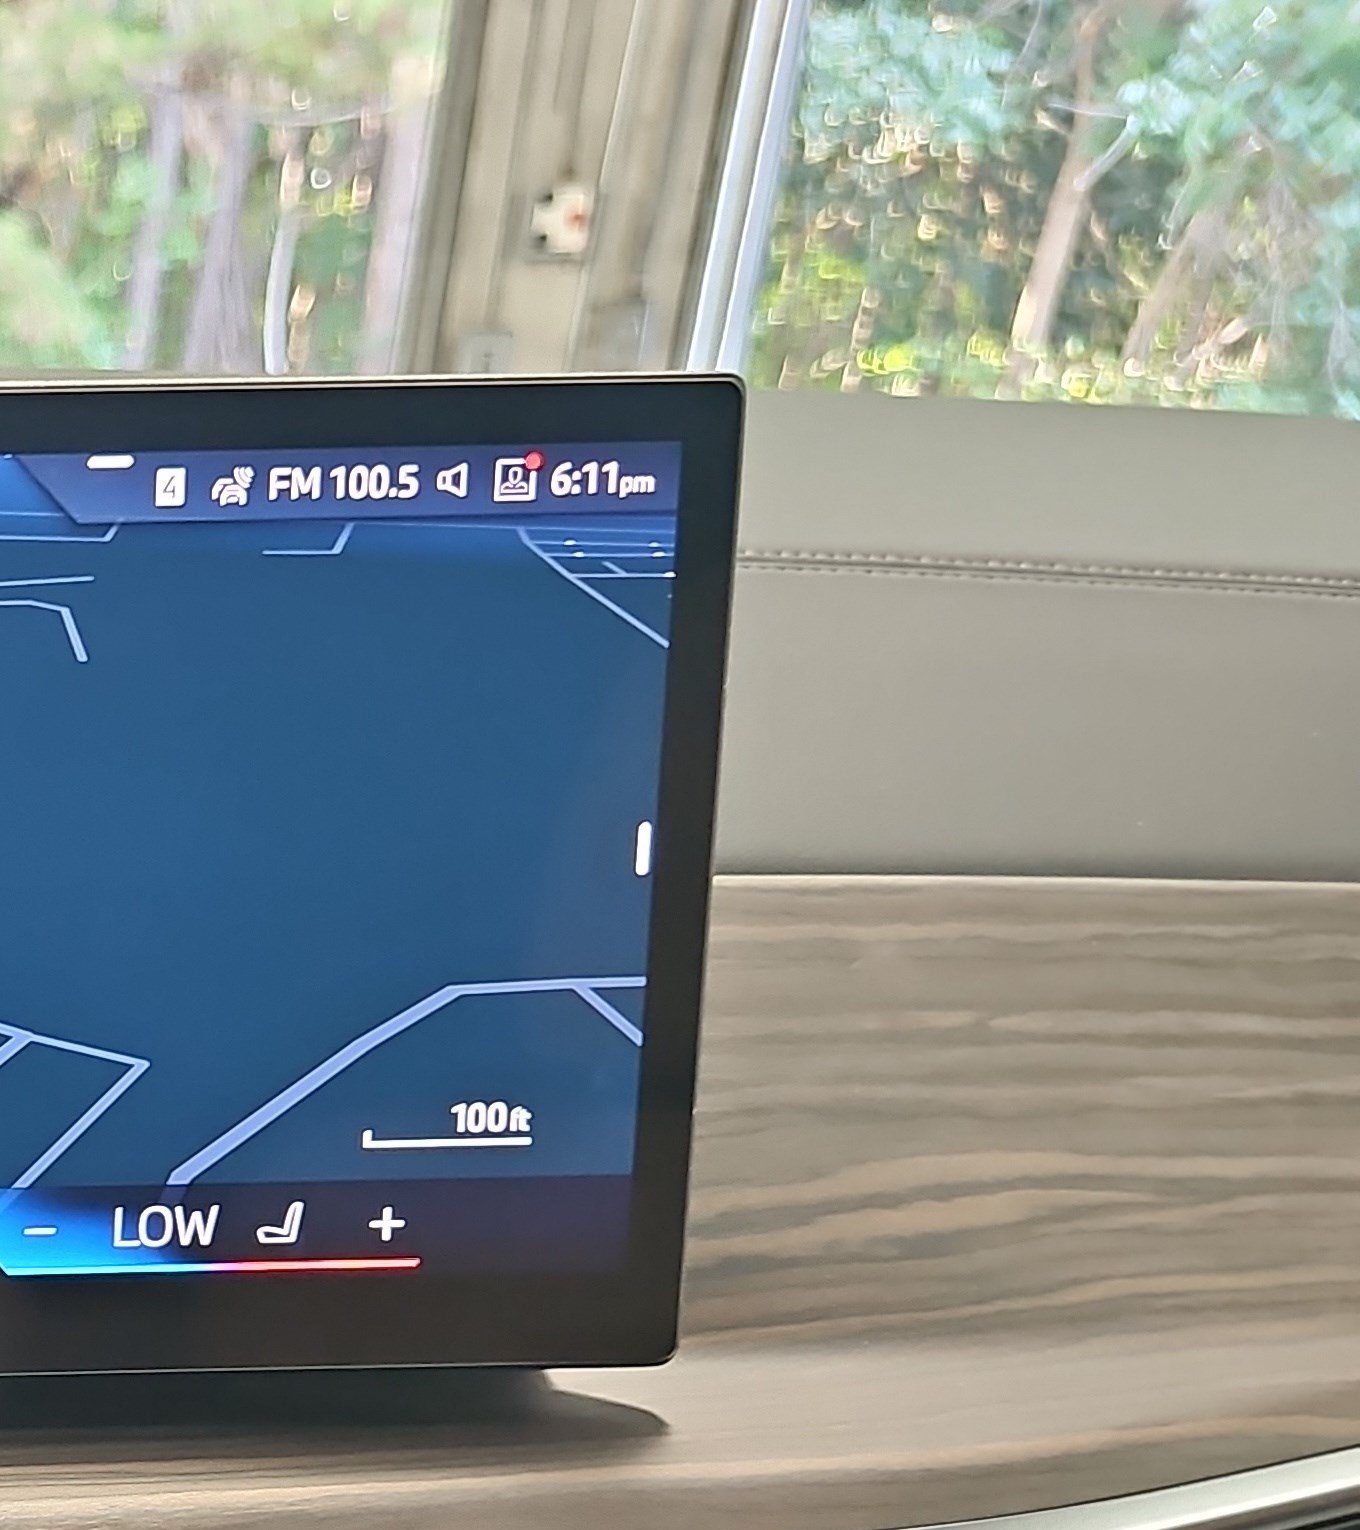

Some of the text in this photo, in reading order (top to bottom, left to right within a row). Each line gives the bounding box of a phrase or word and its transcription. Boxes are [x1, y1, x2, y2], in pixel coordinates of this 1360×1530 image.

[268, 464, 419, 500] FM 100.5
[113, 1205, 220, 1248] LOW
